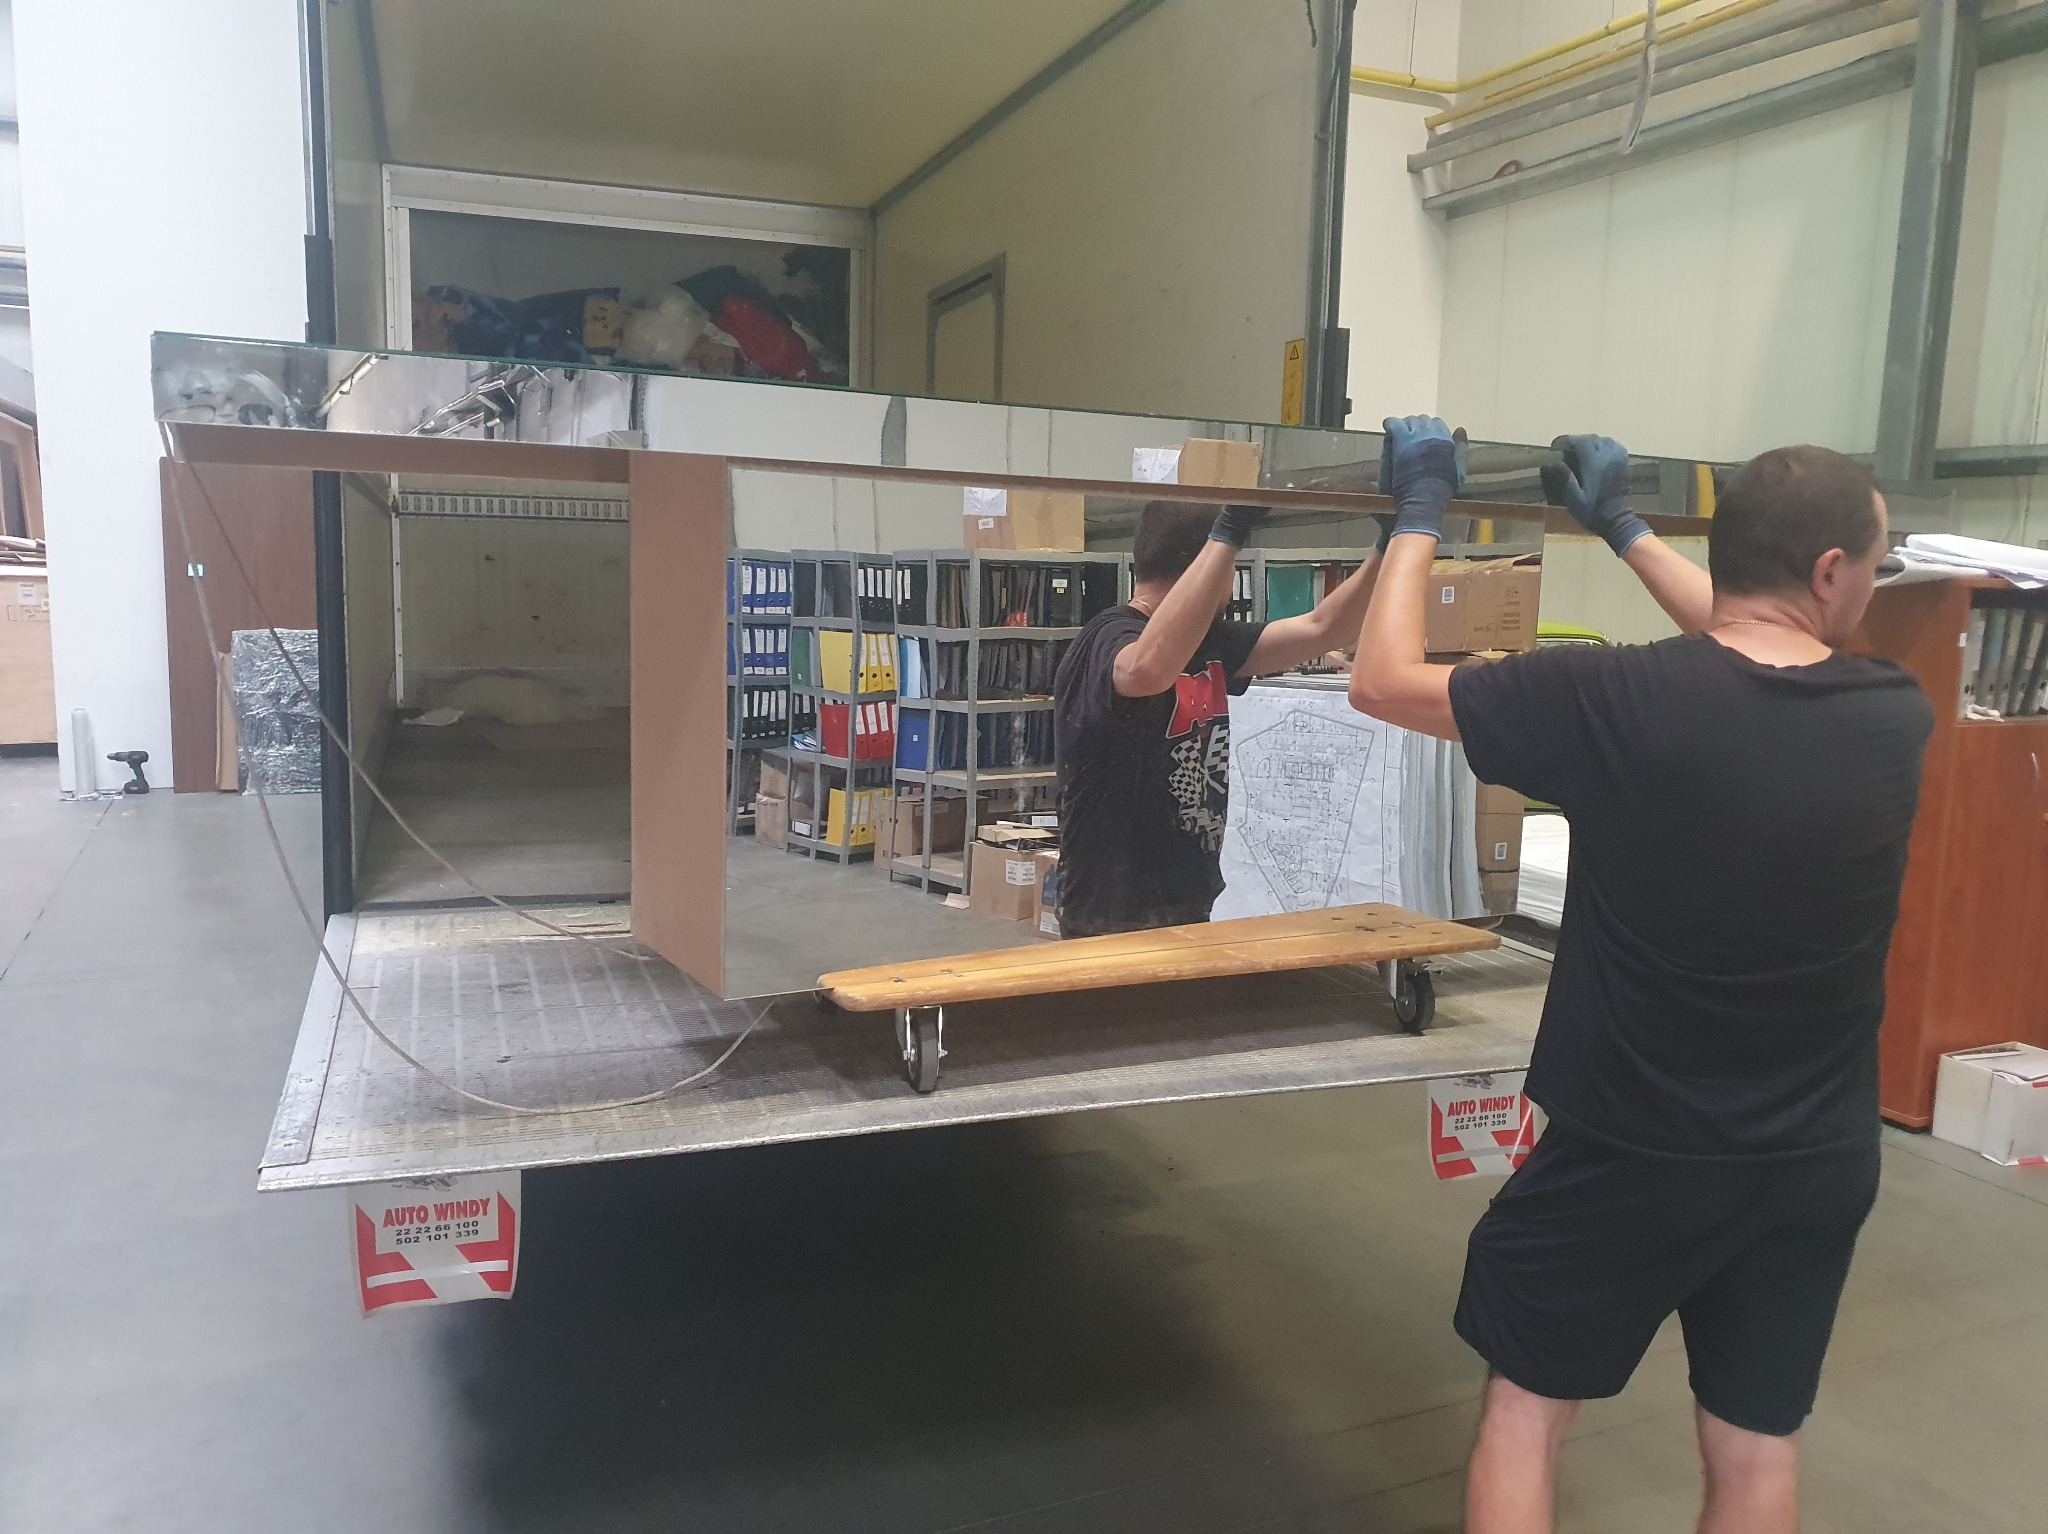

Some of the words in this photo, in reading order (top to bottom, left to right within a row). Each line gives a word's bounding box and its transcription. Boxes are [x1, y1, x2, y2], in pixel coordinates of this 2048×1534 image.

[1448, 1100, 1476, 1116] AUTO
[1479, 1096, 1515, 1113] WINDY
[383, 1205, 429, 1228] AUTO
[433, 1198, 490, 1221] WINDY
[395, 1228, 411, 1237] 22
[415, 1226, 431, 1234] 22
[435, 1223, 451, 1231] 66
[455, 1220, 479, 1230] 100
[395, 1236, 421, 1245] 502
[426, 1232, 449, 1242] 101
[455, 1229, 479, 1238] 339
